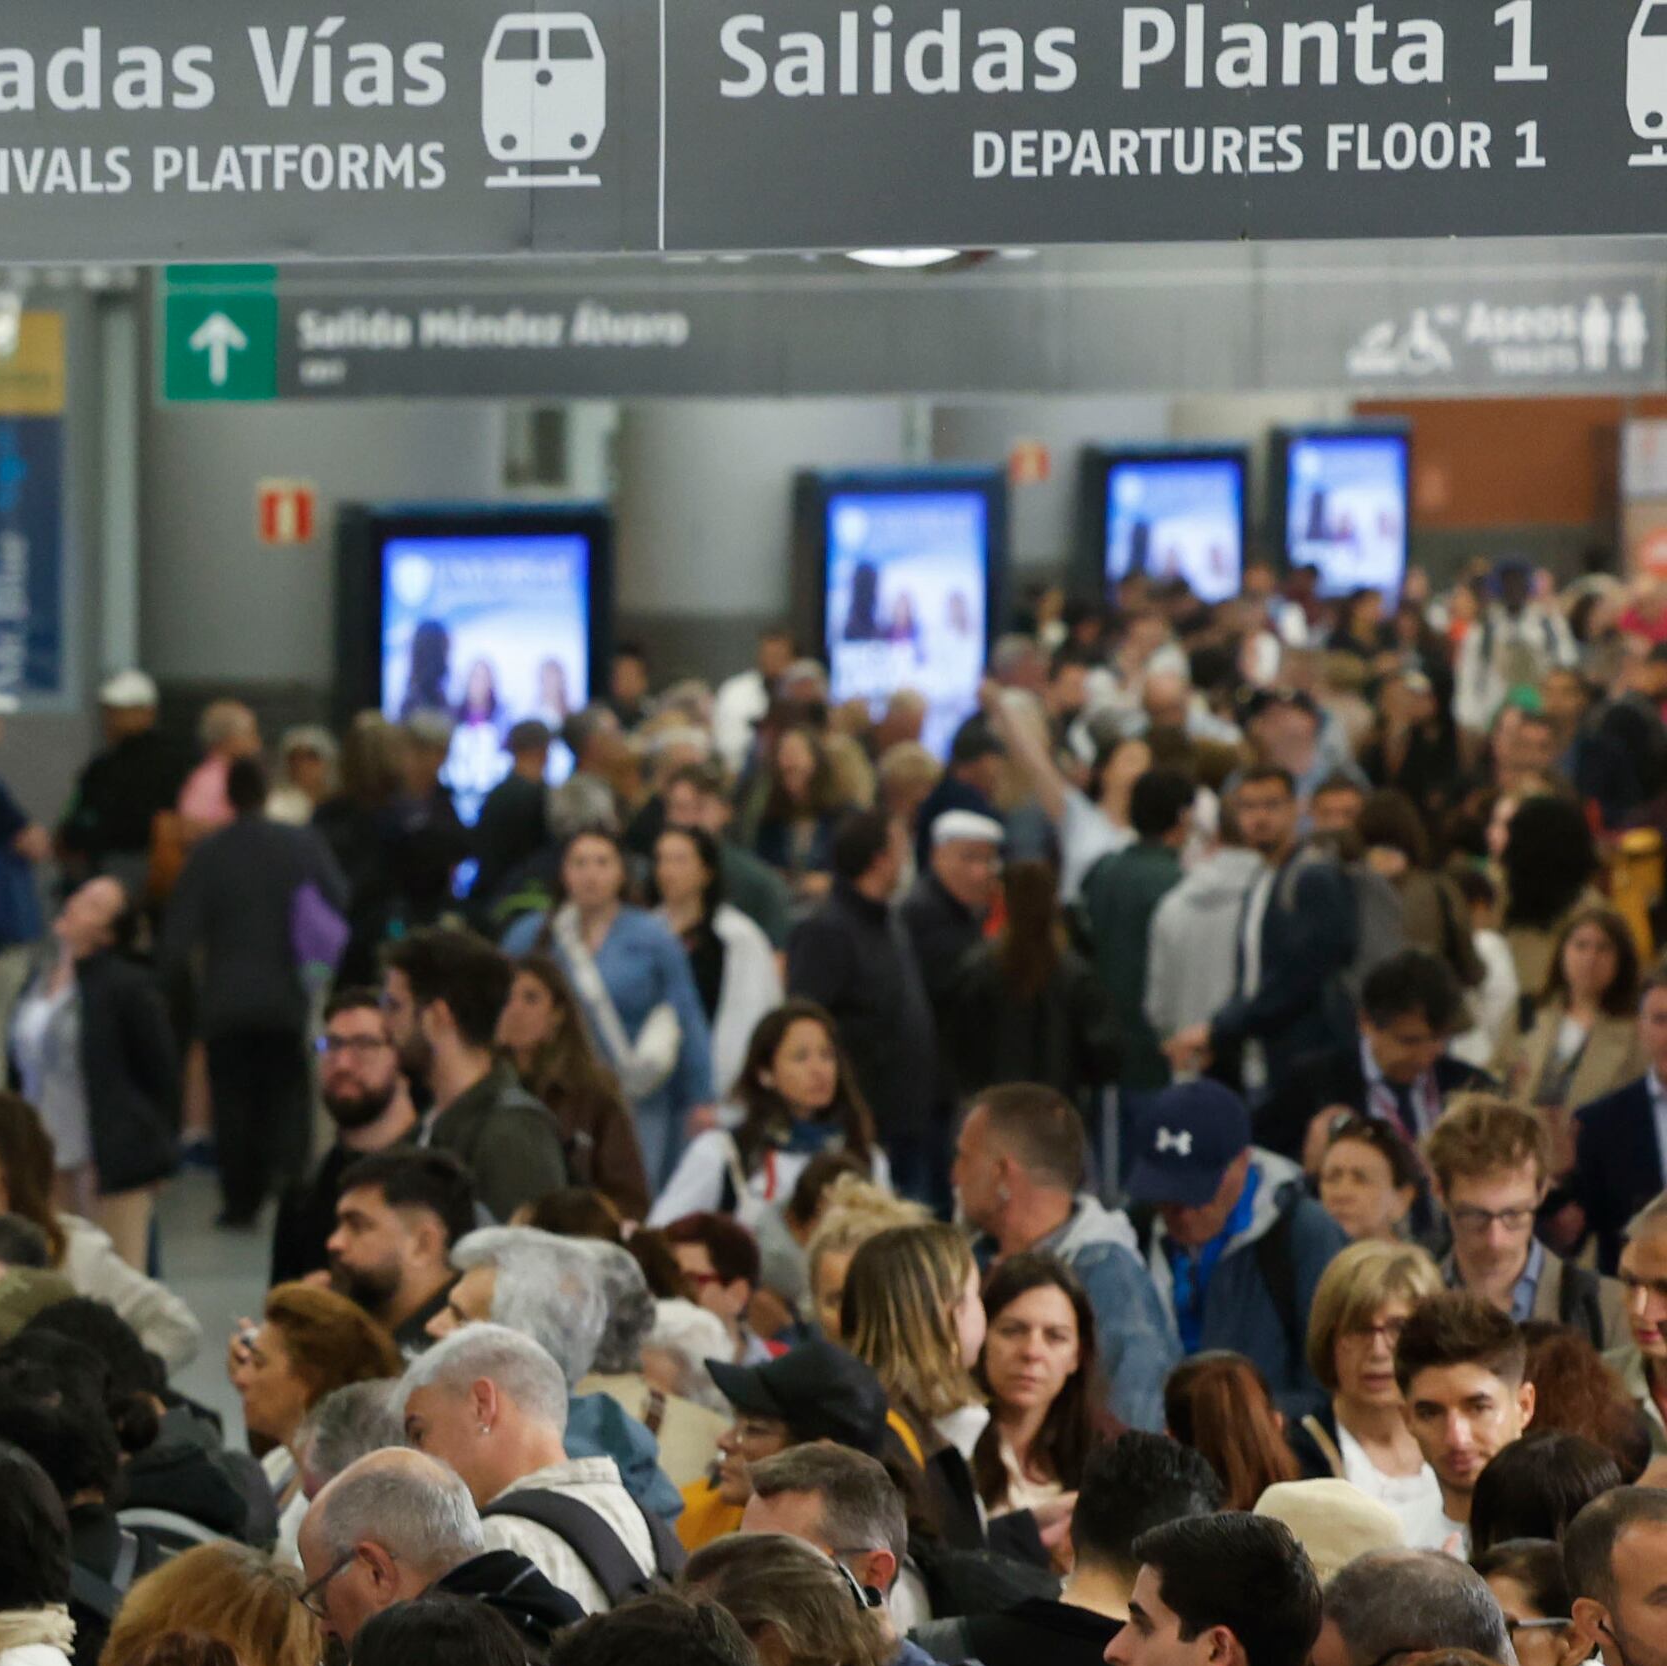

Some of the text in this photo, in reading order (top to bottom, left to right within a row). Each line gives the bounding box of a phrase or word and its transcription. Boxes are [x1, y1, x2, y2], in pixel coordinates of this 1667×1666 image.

[248, 16, 446, 109] Vías
[718, 0, 1548, 98] Salidas Planta 1
[152, 142, 446, 193] PLATFORMS
[972, 120, 1547, 178] DEPARTURES FLOOR 1
[298, 309, 411, 349] Salida
